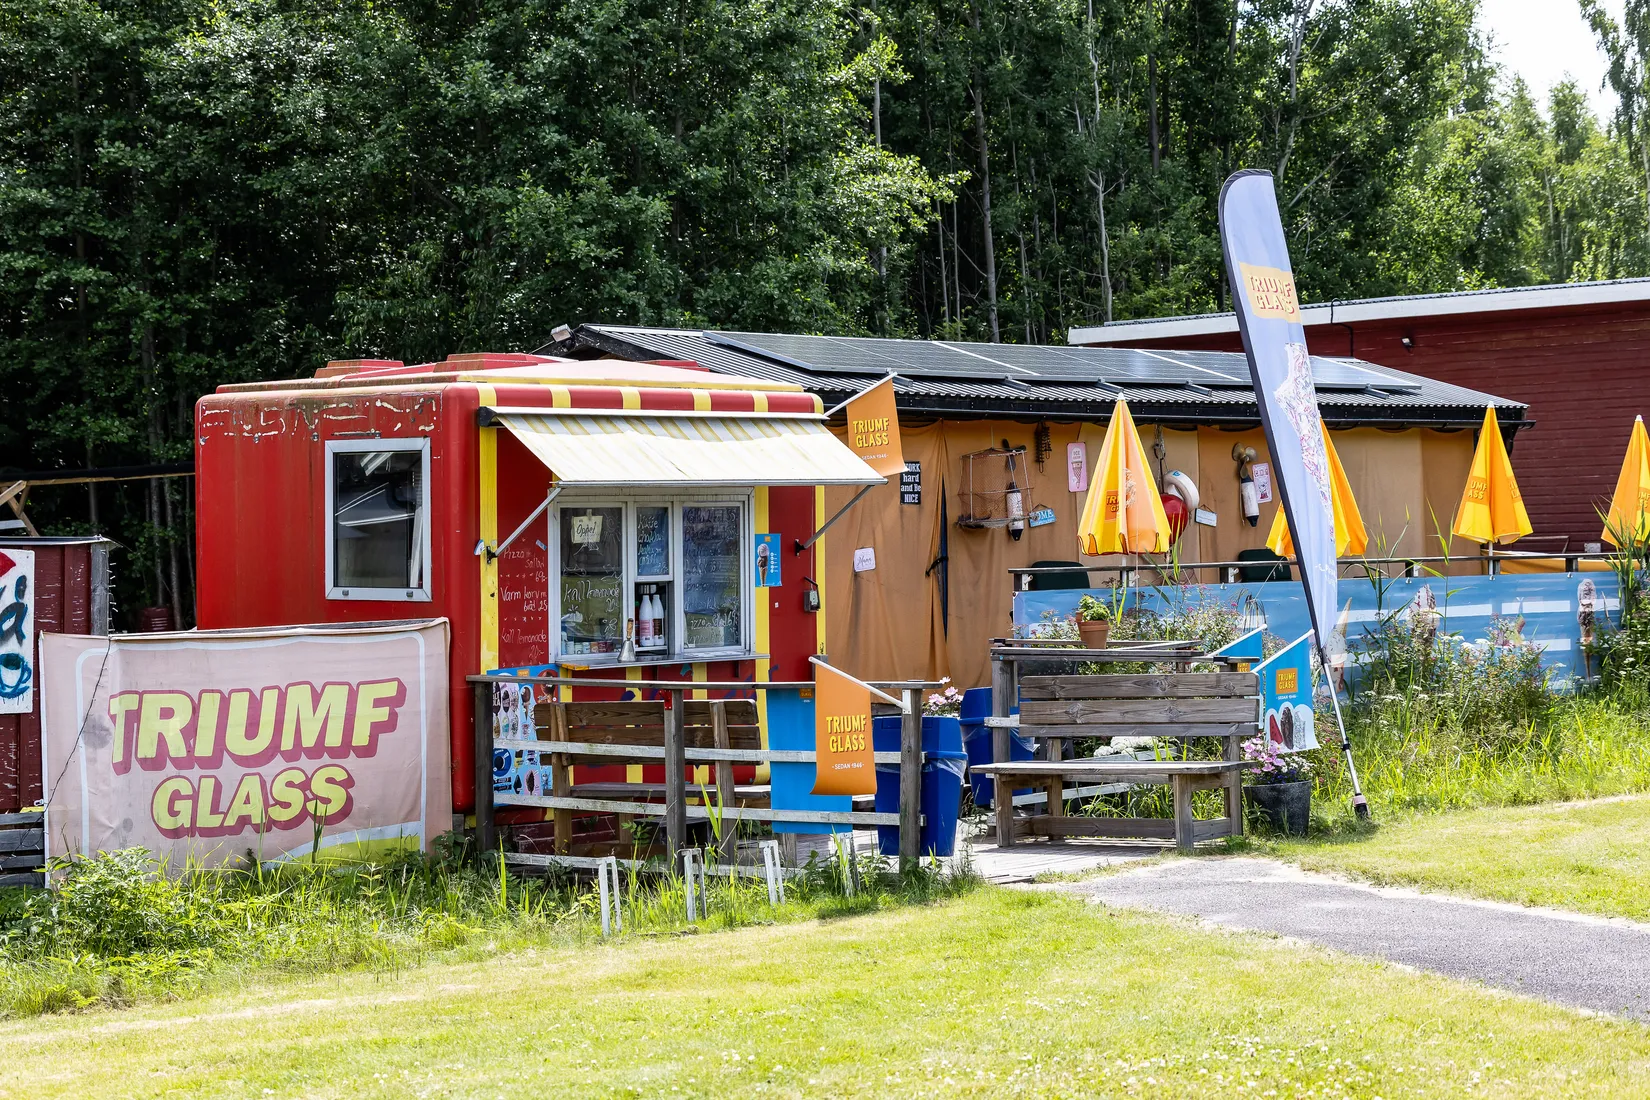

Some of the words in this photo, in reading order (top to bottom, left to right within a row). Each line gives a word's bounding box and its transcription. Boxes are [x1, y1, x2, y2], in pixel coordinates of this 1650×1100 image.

[852, 417, 889, 434] TRIUMF
[856, 432, 889, 448] GLASS
[902, 473, 920, 482] hard
[900, 484, 913, 492] and
[904, 494, 919, 503] NICE
[501, 585, 521, 602] Varm
[108, 677, 407, 776] TRIUMF
[825, 714, 866, 734] TRIUMF
[829, 733, 866, 753] GLASS
[151, 763, 355, 839] GLASS
